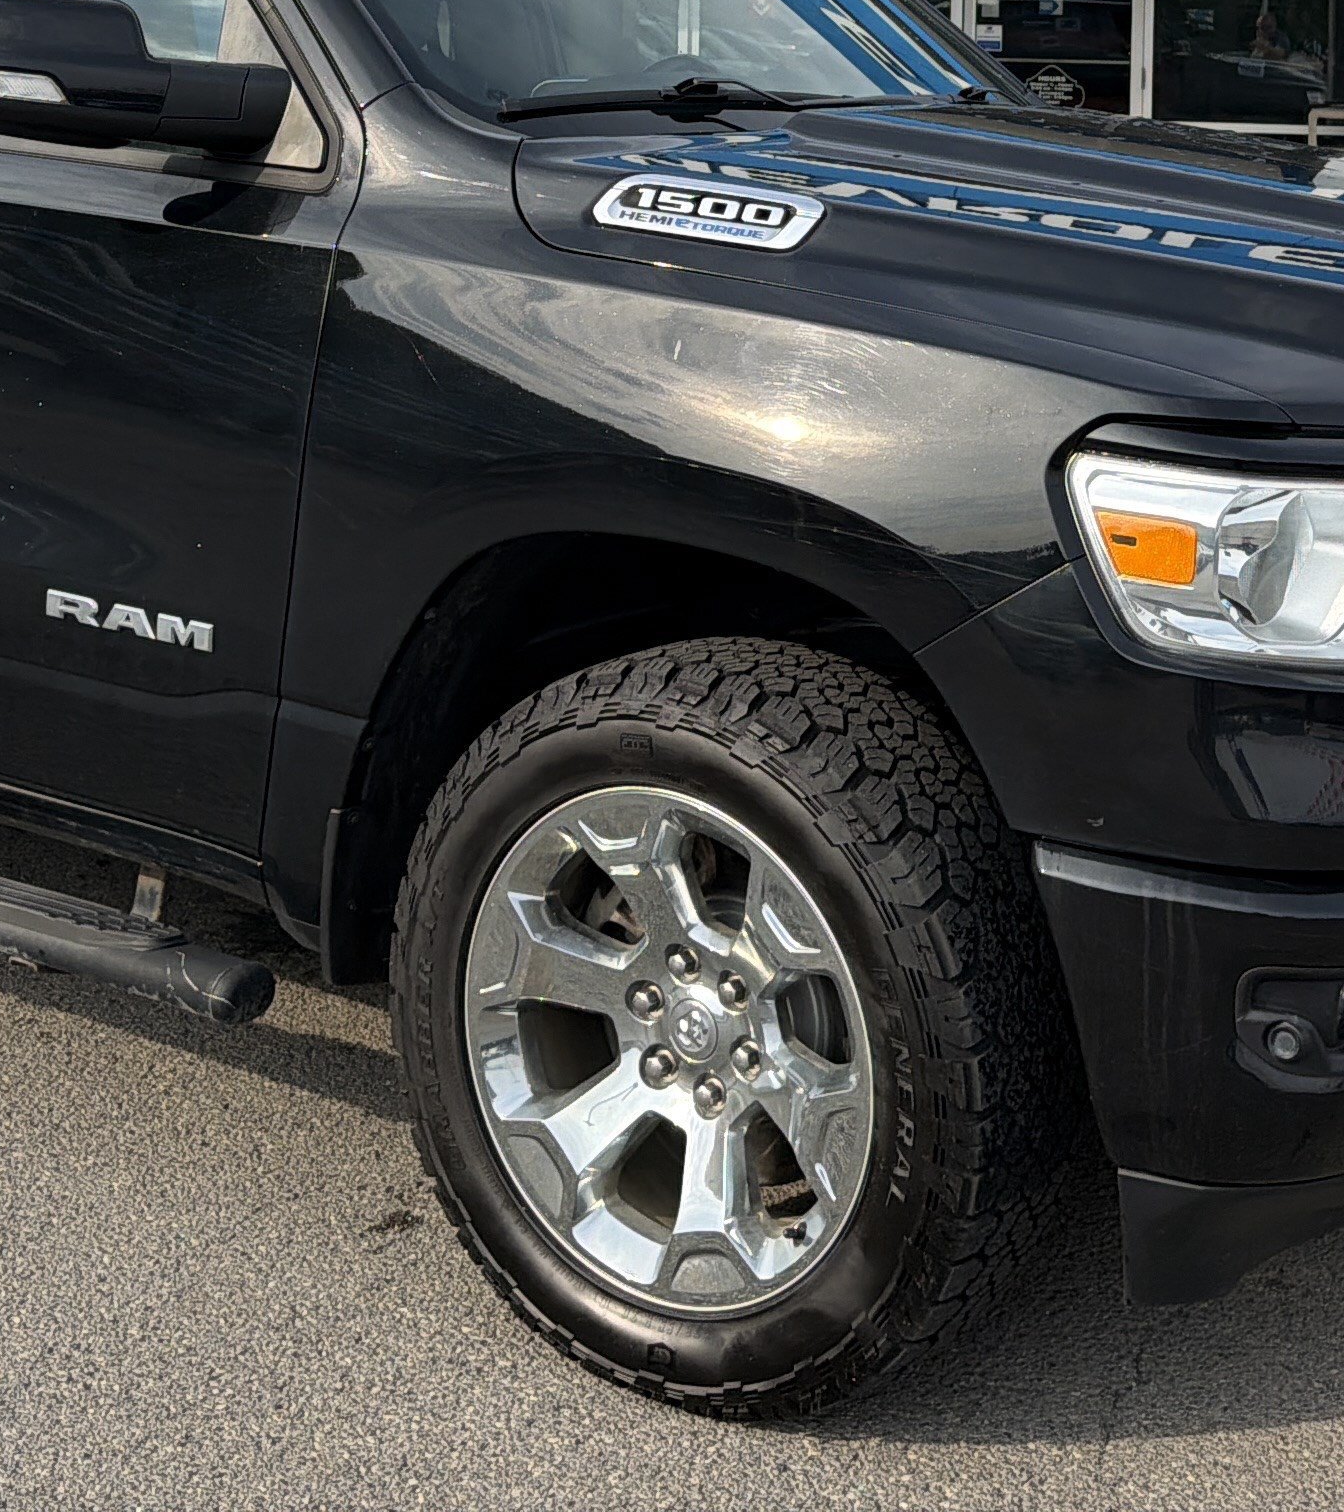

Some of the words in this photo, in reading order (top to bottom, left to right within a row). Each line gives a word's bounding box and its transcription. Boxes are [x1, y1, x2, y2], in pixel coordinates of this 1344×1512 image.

[637, 187, 785, 226] 1500
[45, 588, 215, 653] RAM
[869, 967, 916, 1207] GENERAL
